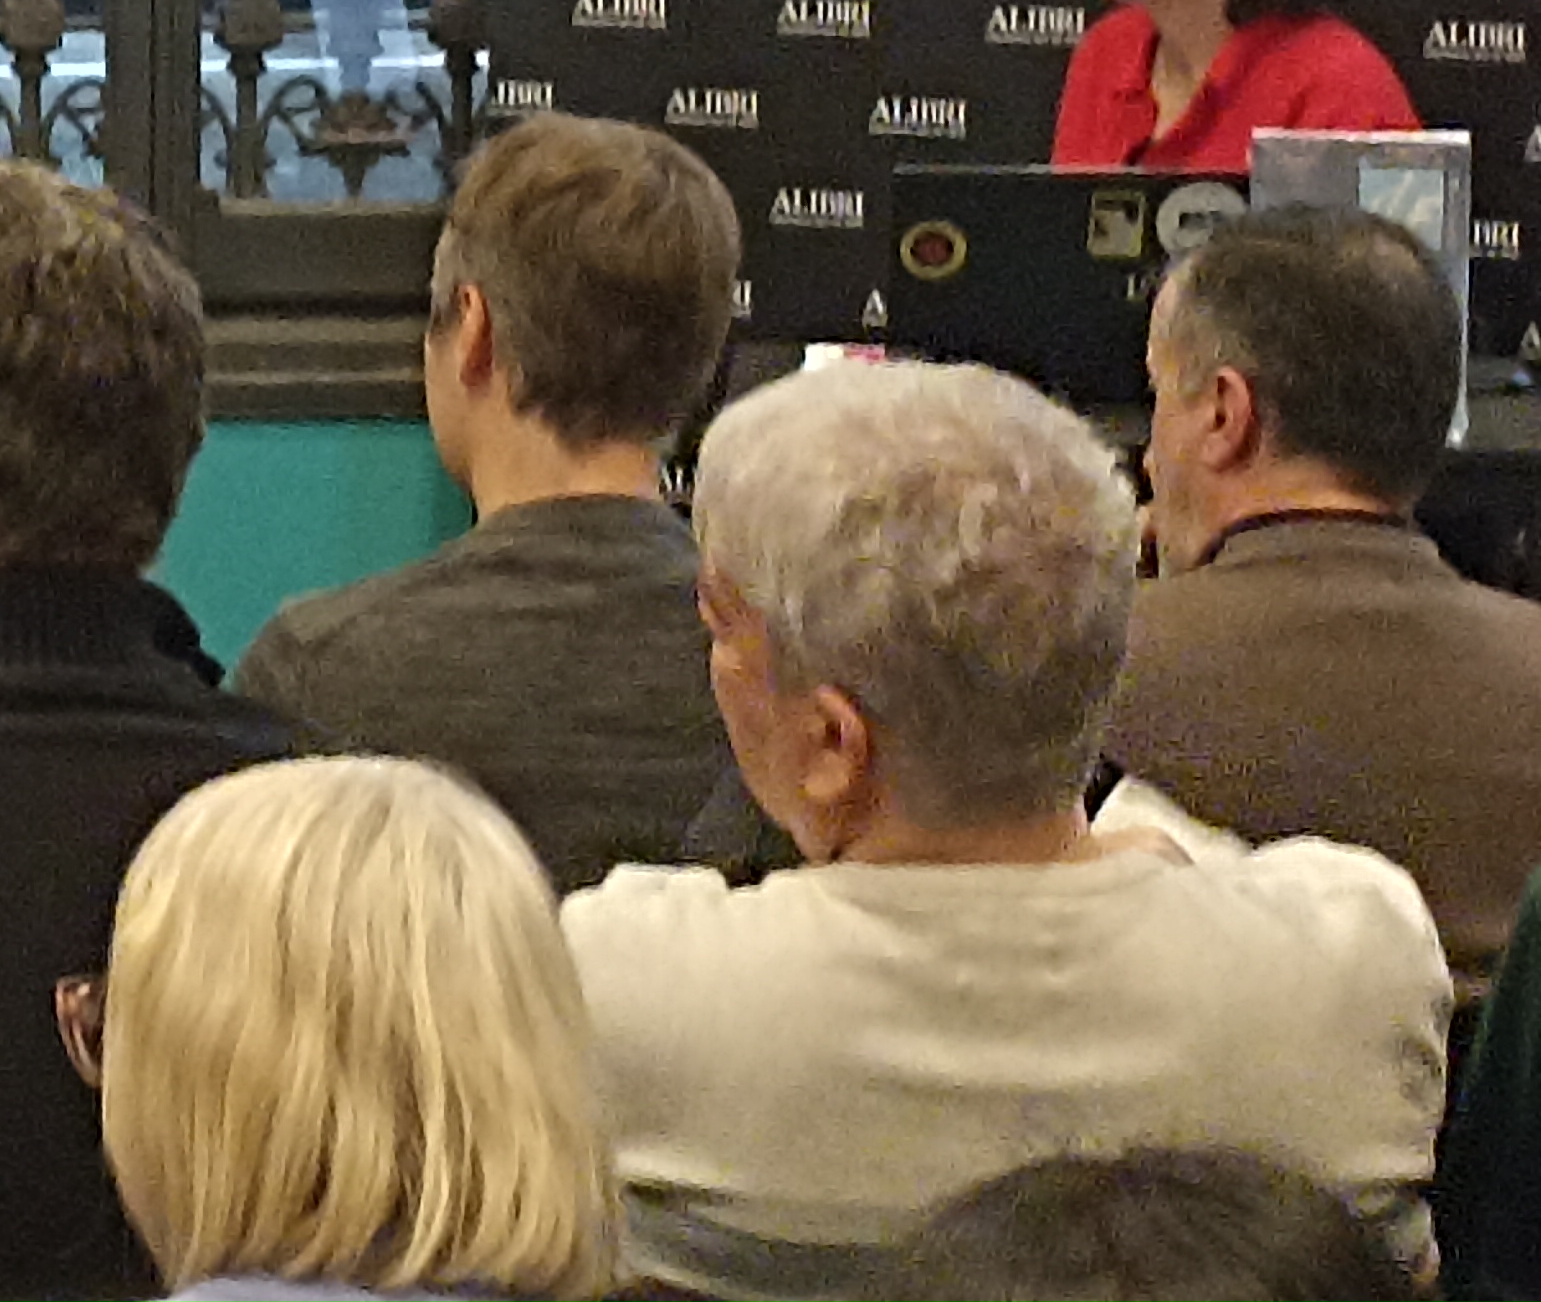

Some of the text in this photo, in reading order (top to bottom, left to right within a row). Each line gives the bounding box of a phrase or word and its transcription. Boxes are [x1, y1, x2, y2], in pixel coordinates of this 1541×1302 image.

[988, 5, 1084, 33] ALIBRI
[1426, 21, 1525, 49] ALIBRI
[667, 88, 757, 116] ALIBRI
[869, 97, 965, 125] ALIBRI
[772, 188, 863, 216] ALIBRI
